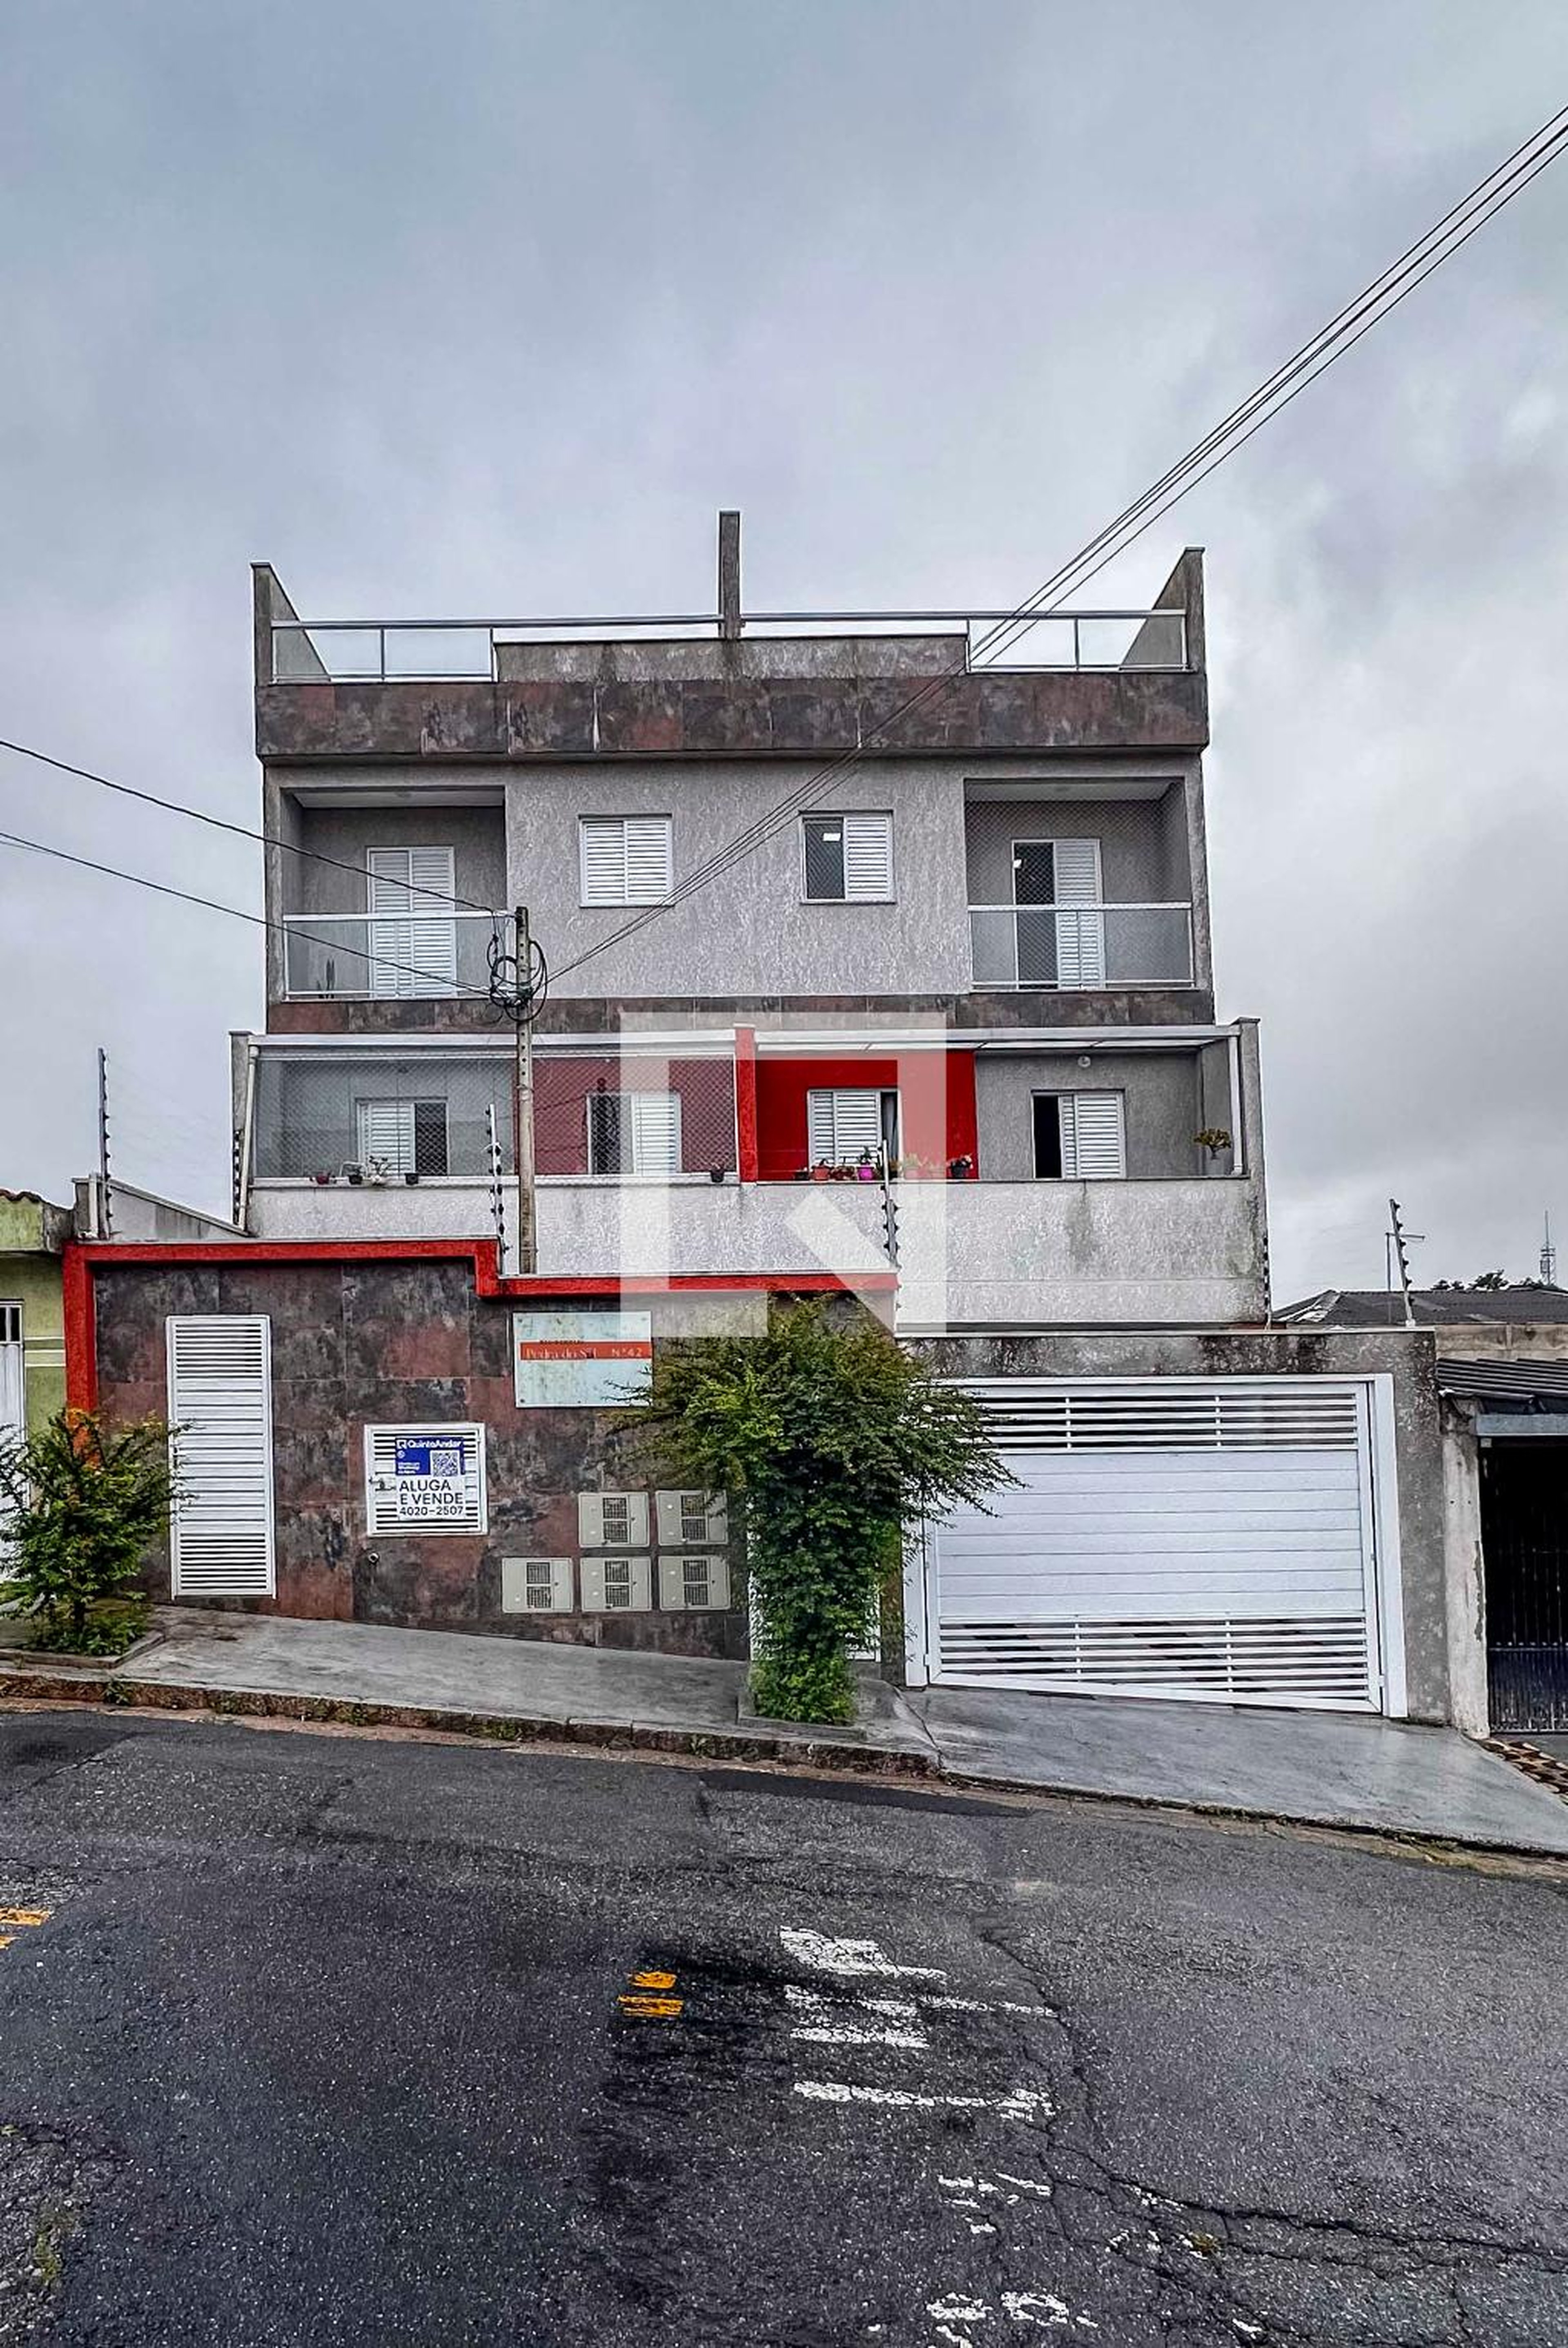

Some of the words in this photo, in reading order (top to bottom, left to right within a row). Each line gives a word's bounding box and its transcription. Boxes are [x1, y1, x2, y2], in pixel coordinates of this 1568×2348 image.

[407, 1439, 462, 1448] QuintoAndar
[399, 1479, 451, 1492] ALUGA
[400, 1493, 408, 1505] E
[412, 1493, 463, 1505] VENDE
[399, 1506, 463, 1515] 4020-2507
